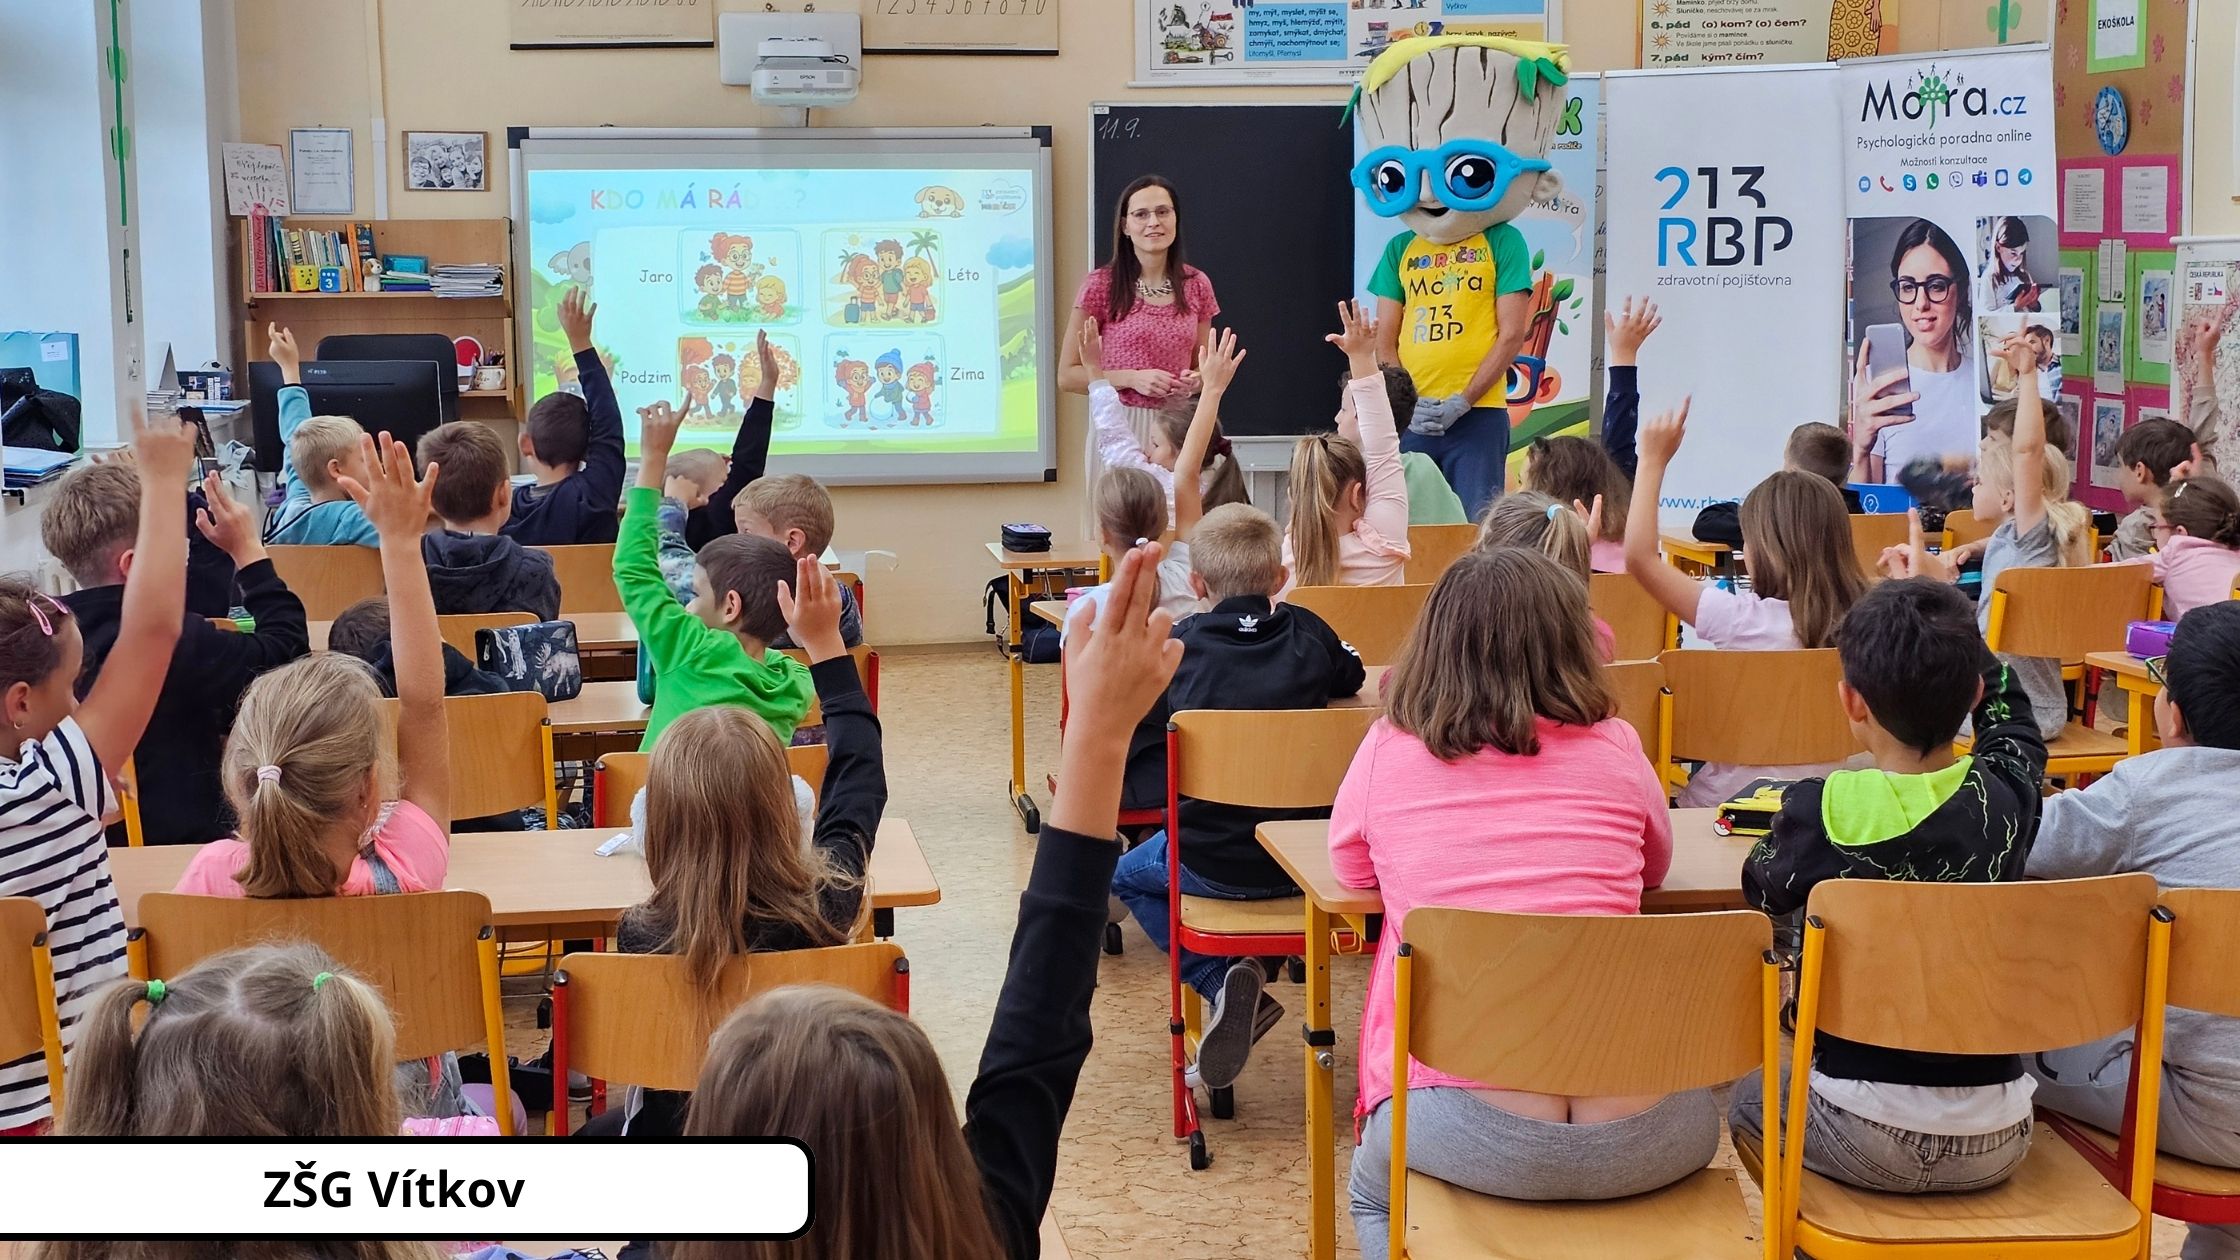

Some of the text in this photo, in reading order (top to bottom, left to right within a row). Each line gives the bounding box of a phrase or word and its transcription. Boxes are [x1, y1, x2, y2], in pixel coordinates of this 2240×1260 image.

[1651, 18, 1807, 31] 6. pád (o) kom? (o) čem?
[2097, 15, 2135, 30] EKOŠKOLA
[1650, 51, 1764, 64] 7. pád kým? čím?
[1099, 117, 1141, 139] 11. 9.
[1857, 128, 2032, 152] Psychologická poradna online
[1900, 154, 1988, 167] Možnosti konzultace
[590, 188, 645, 210] KDO
[656, 181, 697, 210] MÁ
[1654, 166, 1767, 210] 213
[1657, 216, 1793, 267] RBP
[639, 269, 674, 283] Jaro
[948, 267, 980, 281] Léto
[1657, 273, 1792, 288] zdravotní pojišťovna
[325, 278, 333, 289] 3
[1414, 304, 1453, 322] 213
[1413, 321, 1464, 343] RBP
[621, 370, 672, 384] Podzim
[950, 367, 985, 381] Zima
